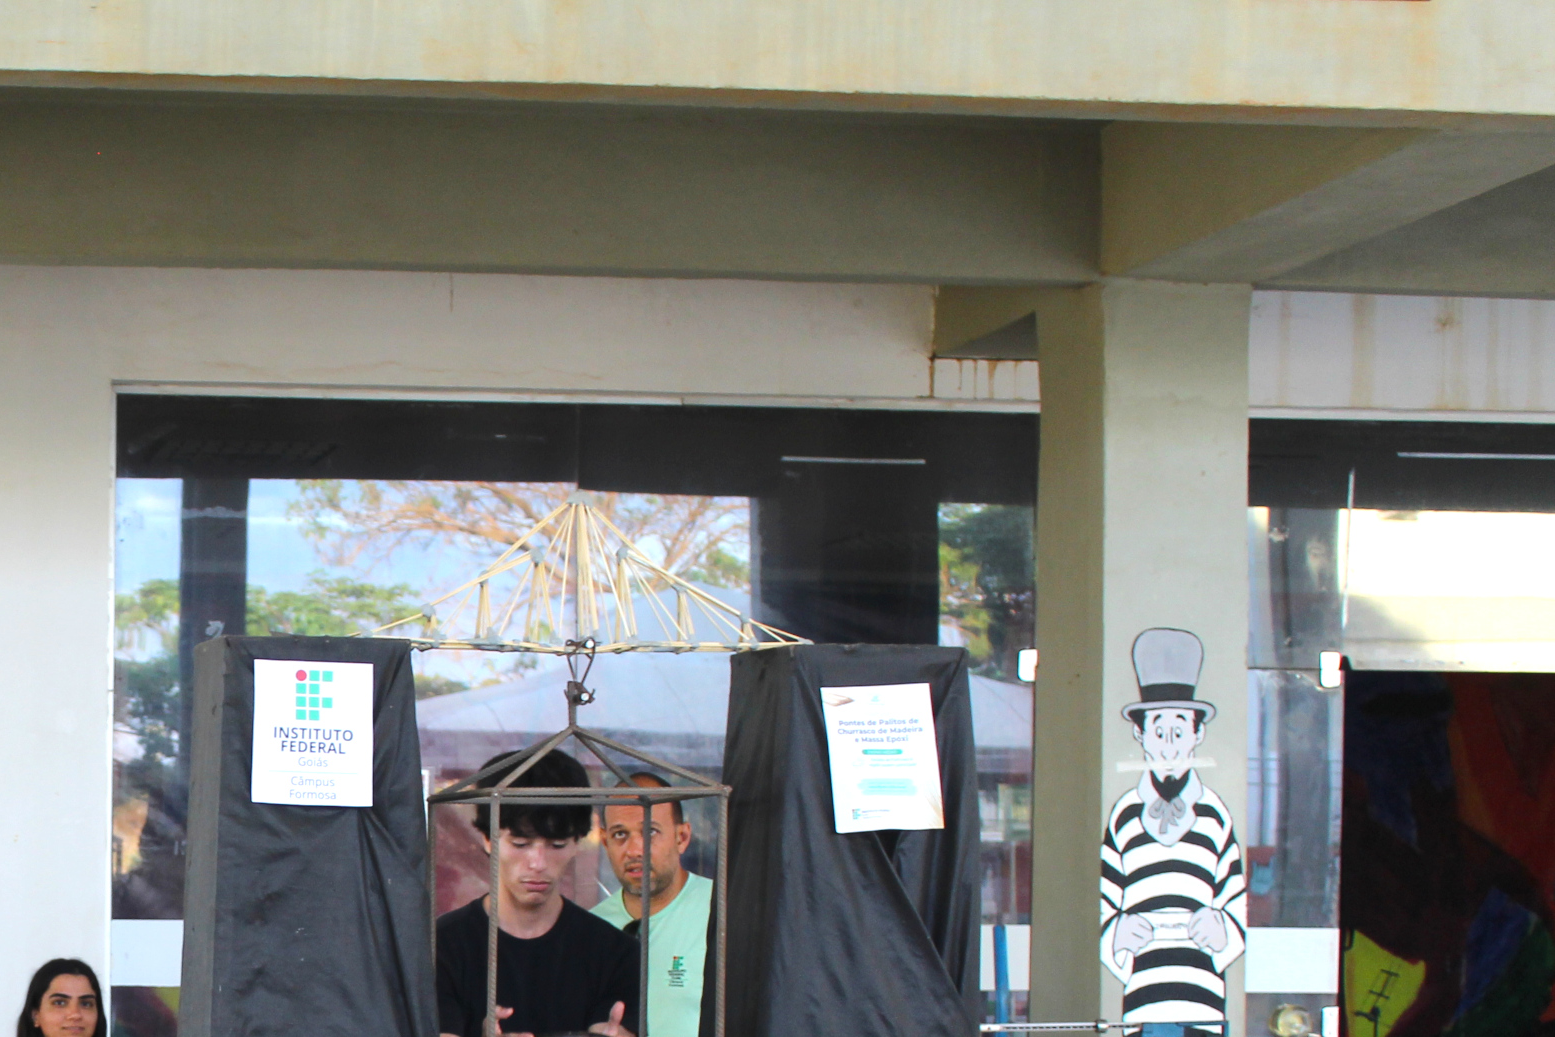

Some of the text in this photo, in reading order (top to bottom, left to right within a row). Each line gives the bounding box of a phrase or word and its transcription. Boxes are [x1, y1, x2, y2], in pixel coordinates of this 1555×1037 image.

[838, 719, 866, 727] Pontes
[878, 718, 907, 726] Palitos
[908, 717, 920, 725] de
[273, 726, 354, 742] INSTITUTO
[837, 725, 924, 736] Churrasco de Madeira
[280, 740, 347, 755] FEDERAL
[297, 756, 329, 768] Goiás
[290, 775, 336, 789] Câmpus
[289, 789, 337, 801] Formosa
